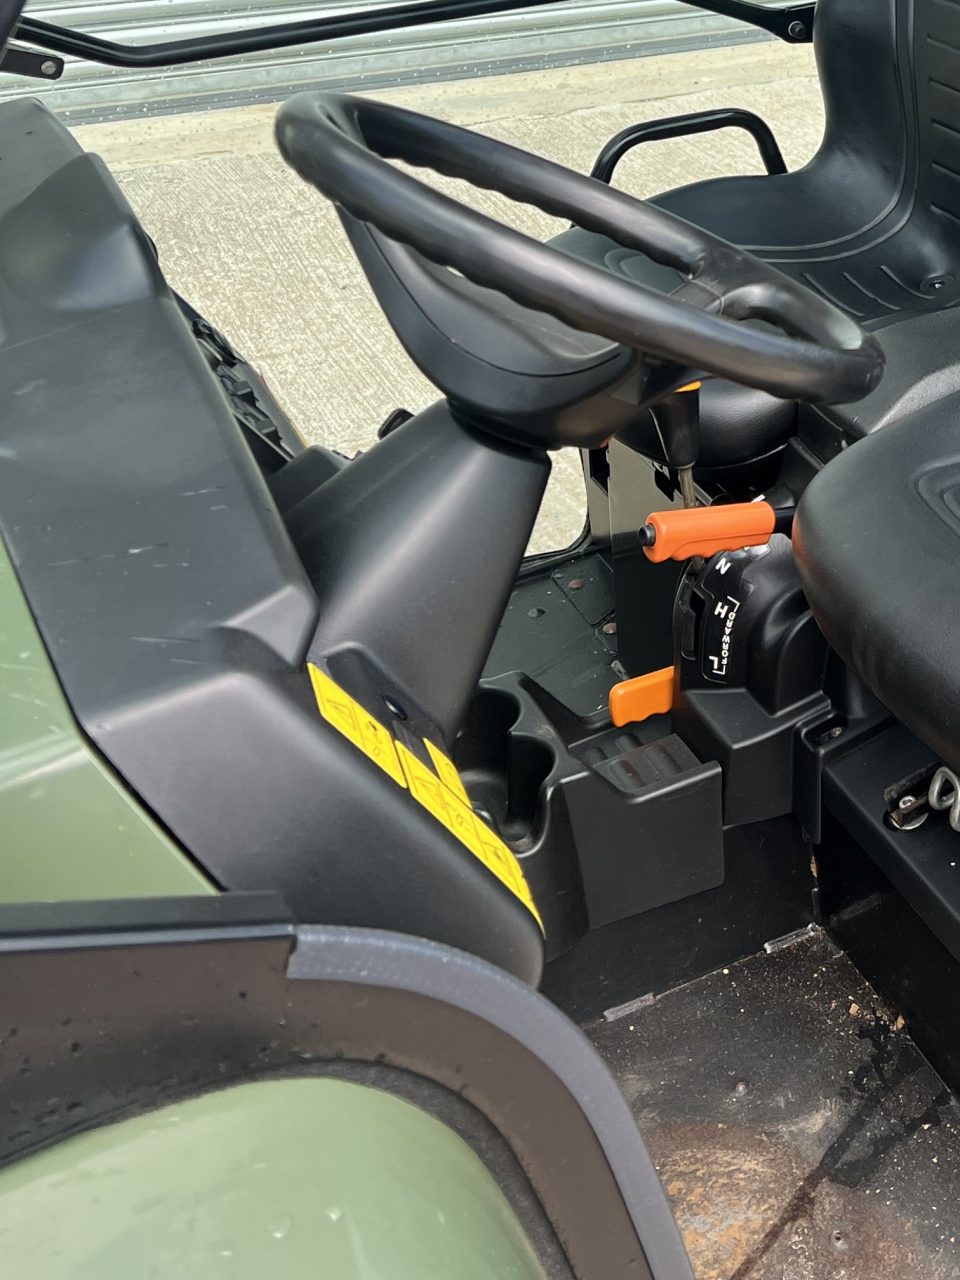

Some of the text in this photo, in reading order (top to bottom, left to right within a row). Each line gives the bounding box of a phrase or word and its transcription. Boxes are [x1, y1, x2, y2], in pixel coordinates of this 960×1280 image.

[715, 558, 731, 575] N
[714, 602, 728, 619] H
[721, 612, 737, 665] FORWARD
[708, 656, 719, 670] L
